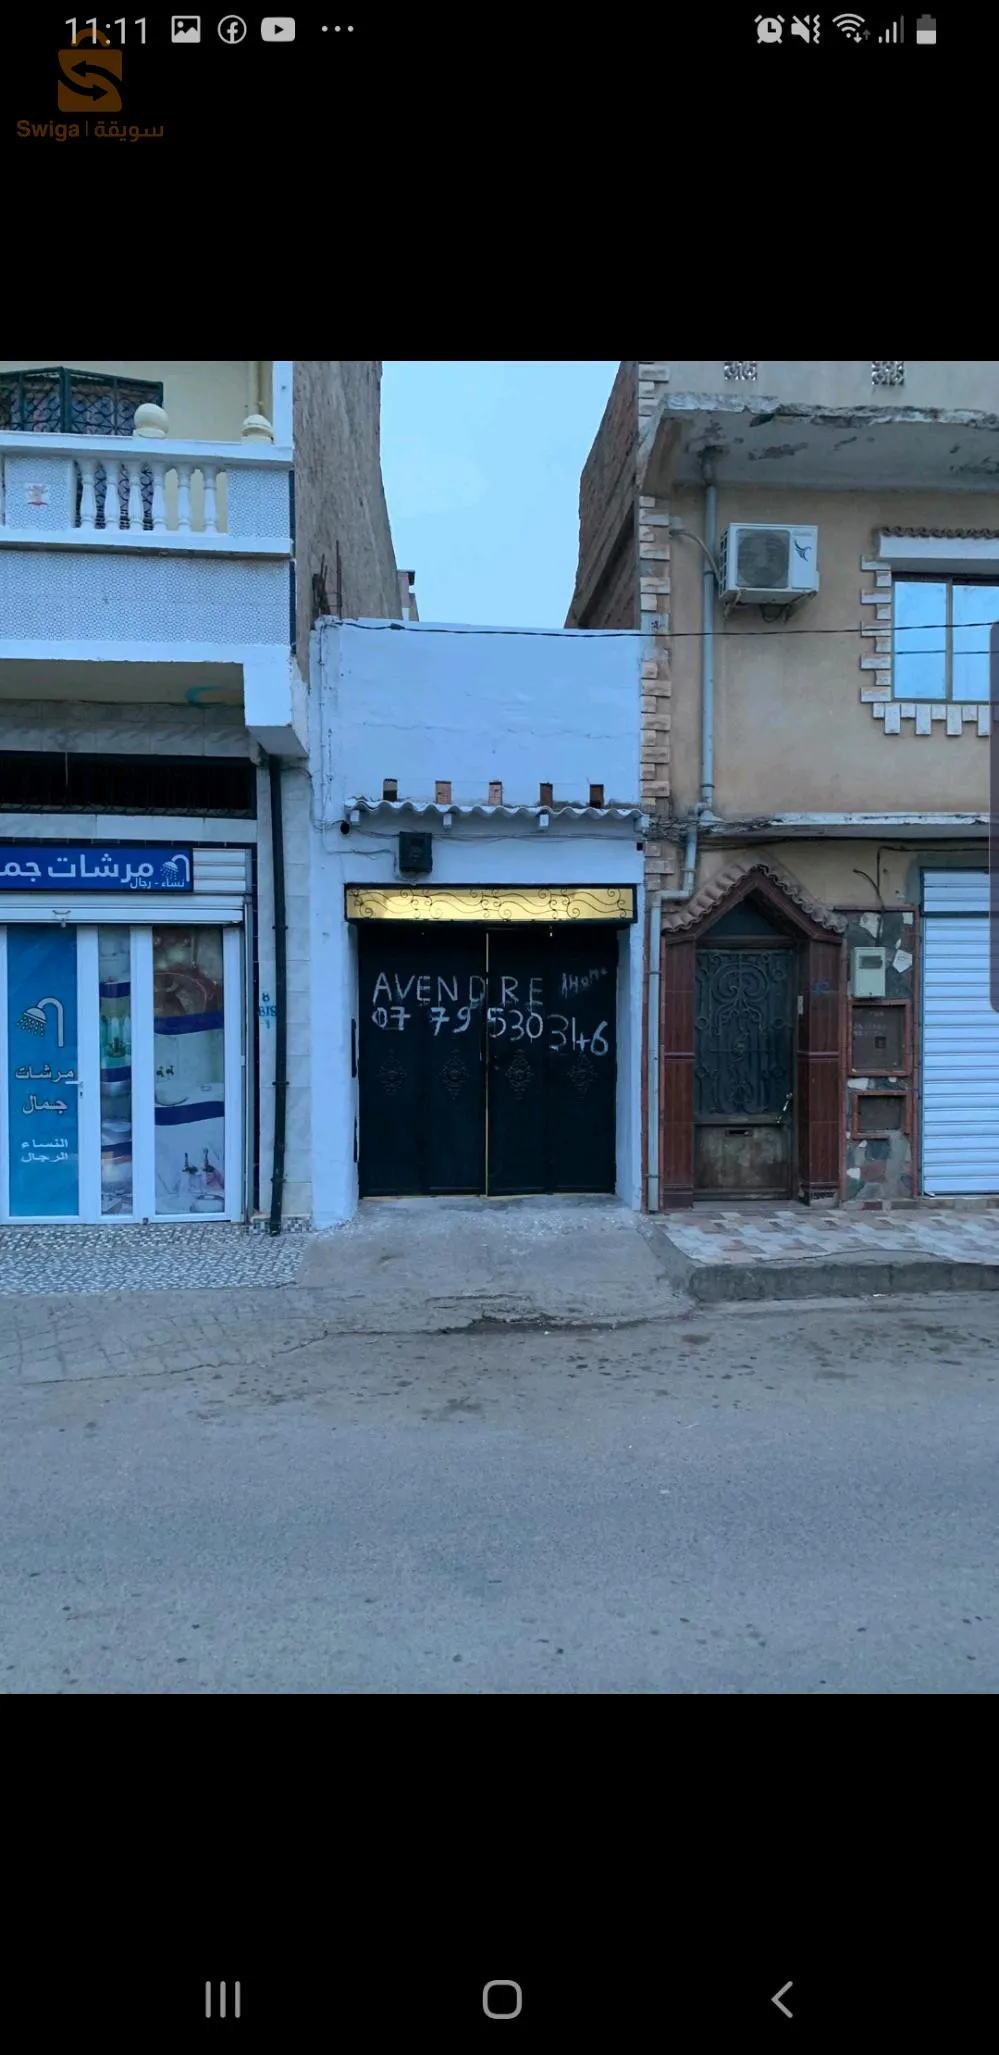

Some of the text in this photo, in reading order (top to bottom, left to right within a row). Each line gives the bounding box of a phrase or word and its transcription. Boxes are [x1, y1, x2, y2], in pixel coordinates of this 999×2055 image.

[47, 853, 154, 884] مرشات
[430, 1006, 477, 1037] 79
[15, 1064, 74, 1083] مرشات
[22, 1094, 68, 1114] جمال
